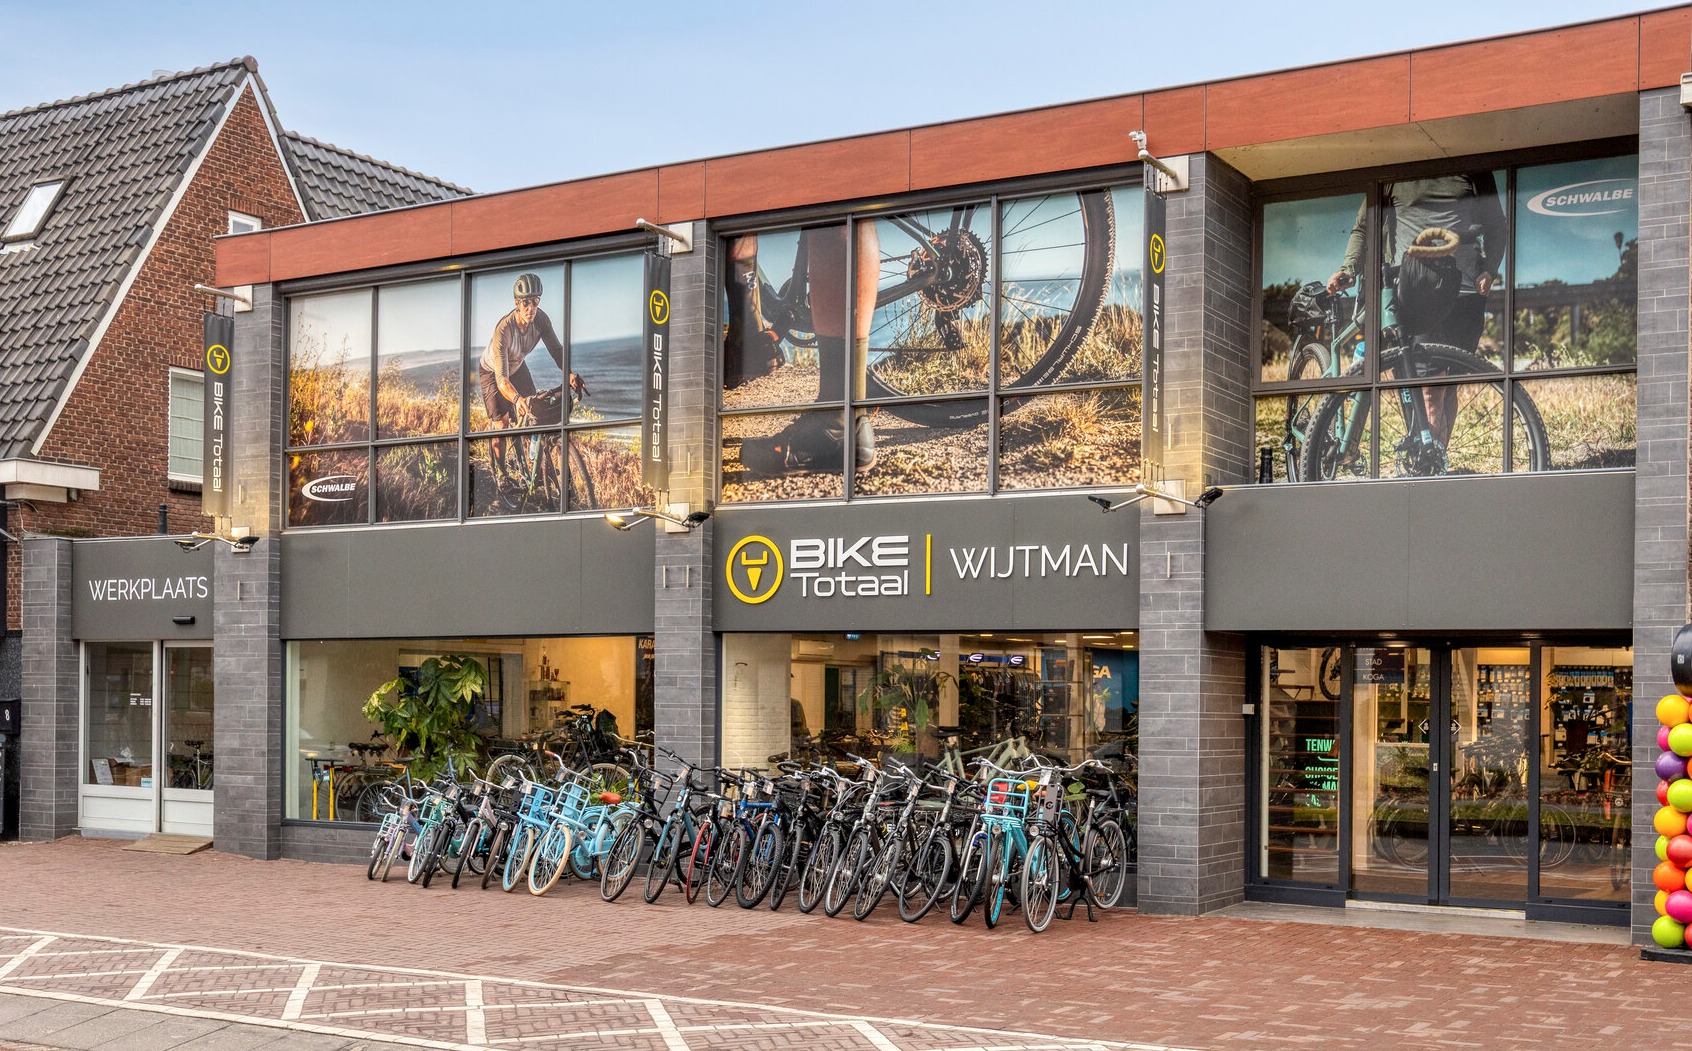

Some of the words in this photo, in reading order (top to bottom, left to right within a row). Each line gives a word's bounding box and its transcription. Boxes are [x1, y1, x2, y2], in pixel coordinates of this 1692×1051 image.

[1546, 188, 1633, 207] SCHWALBE
[653, 333, 663, 391] BIKE
[1042, 325, 1082, 379] SCHWALBE
[213, 381, 224, 431] BIKE
[1152, 354, 1160, 433] Totaal
[652, 394, 662, 462] Totaal
[212, 433, 223, 493] Totaal
[311, 483, 356, 493] SCHWALBE
[790, 535, 909, 569] BIKE
[949, 543, 1128, 579] WIJTMAN
[88, 576, 208, 601] WERKPLAATS
[790, 570, 909, 597] Totaal
[4, 709, 10, 721] 8
[1305, 739, 1335, 752] TENW
